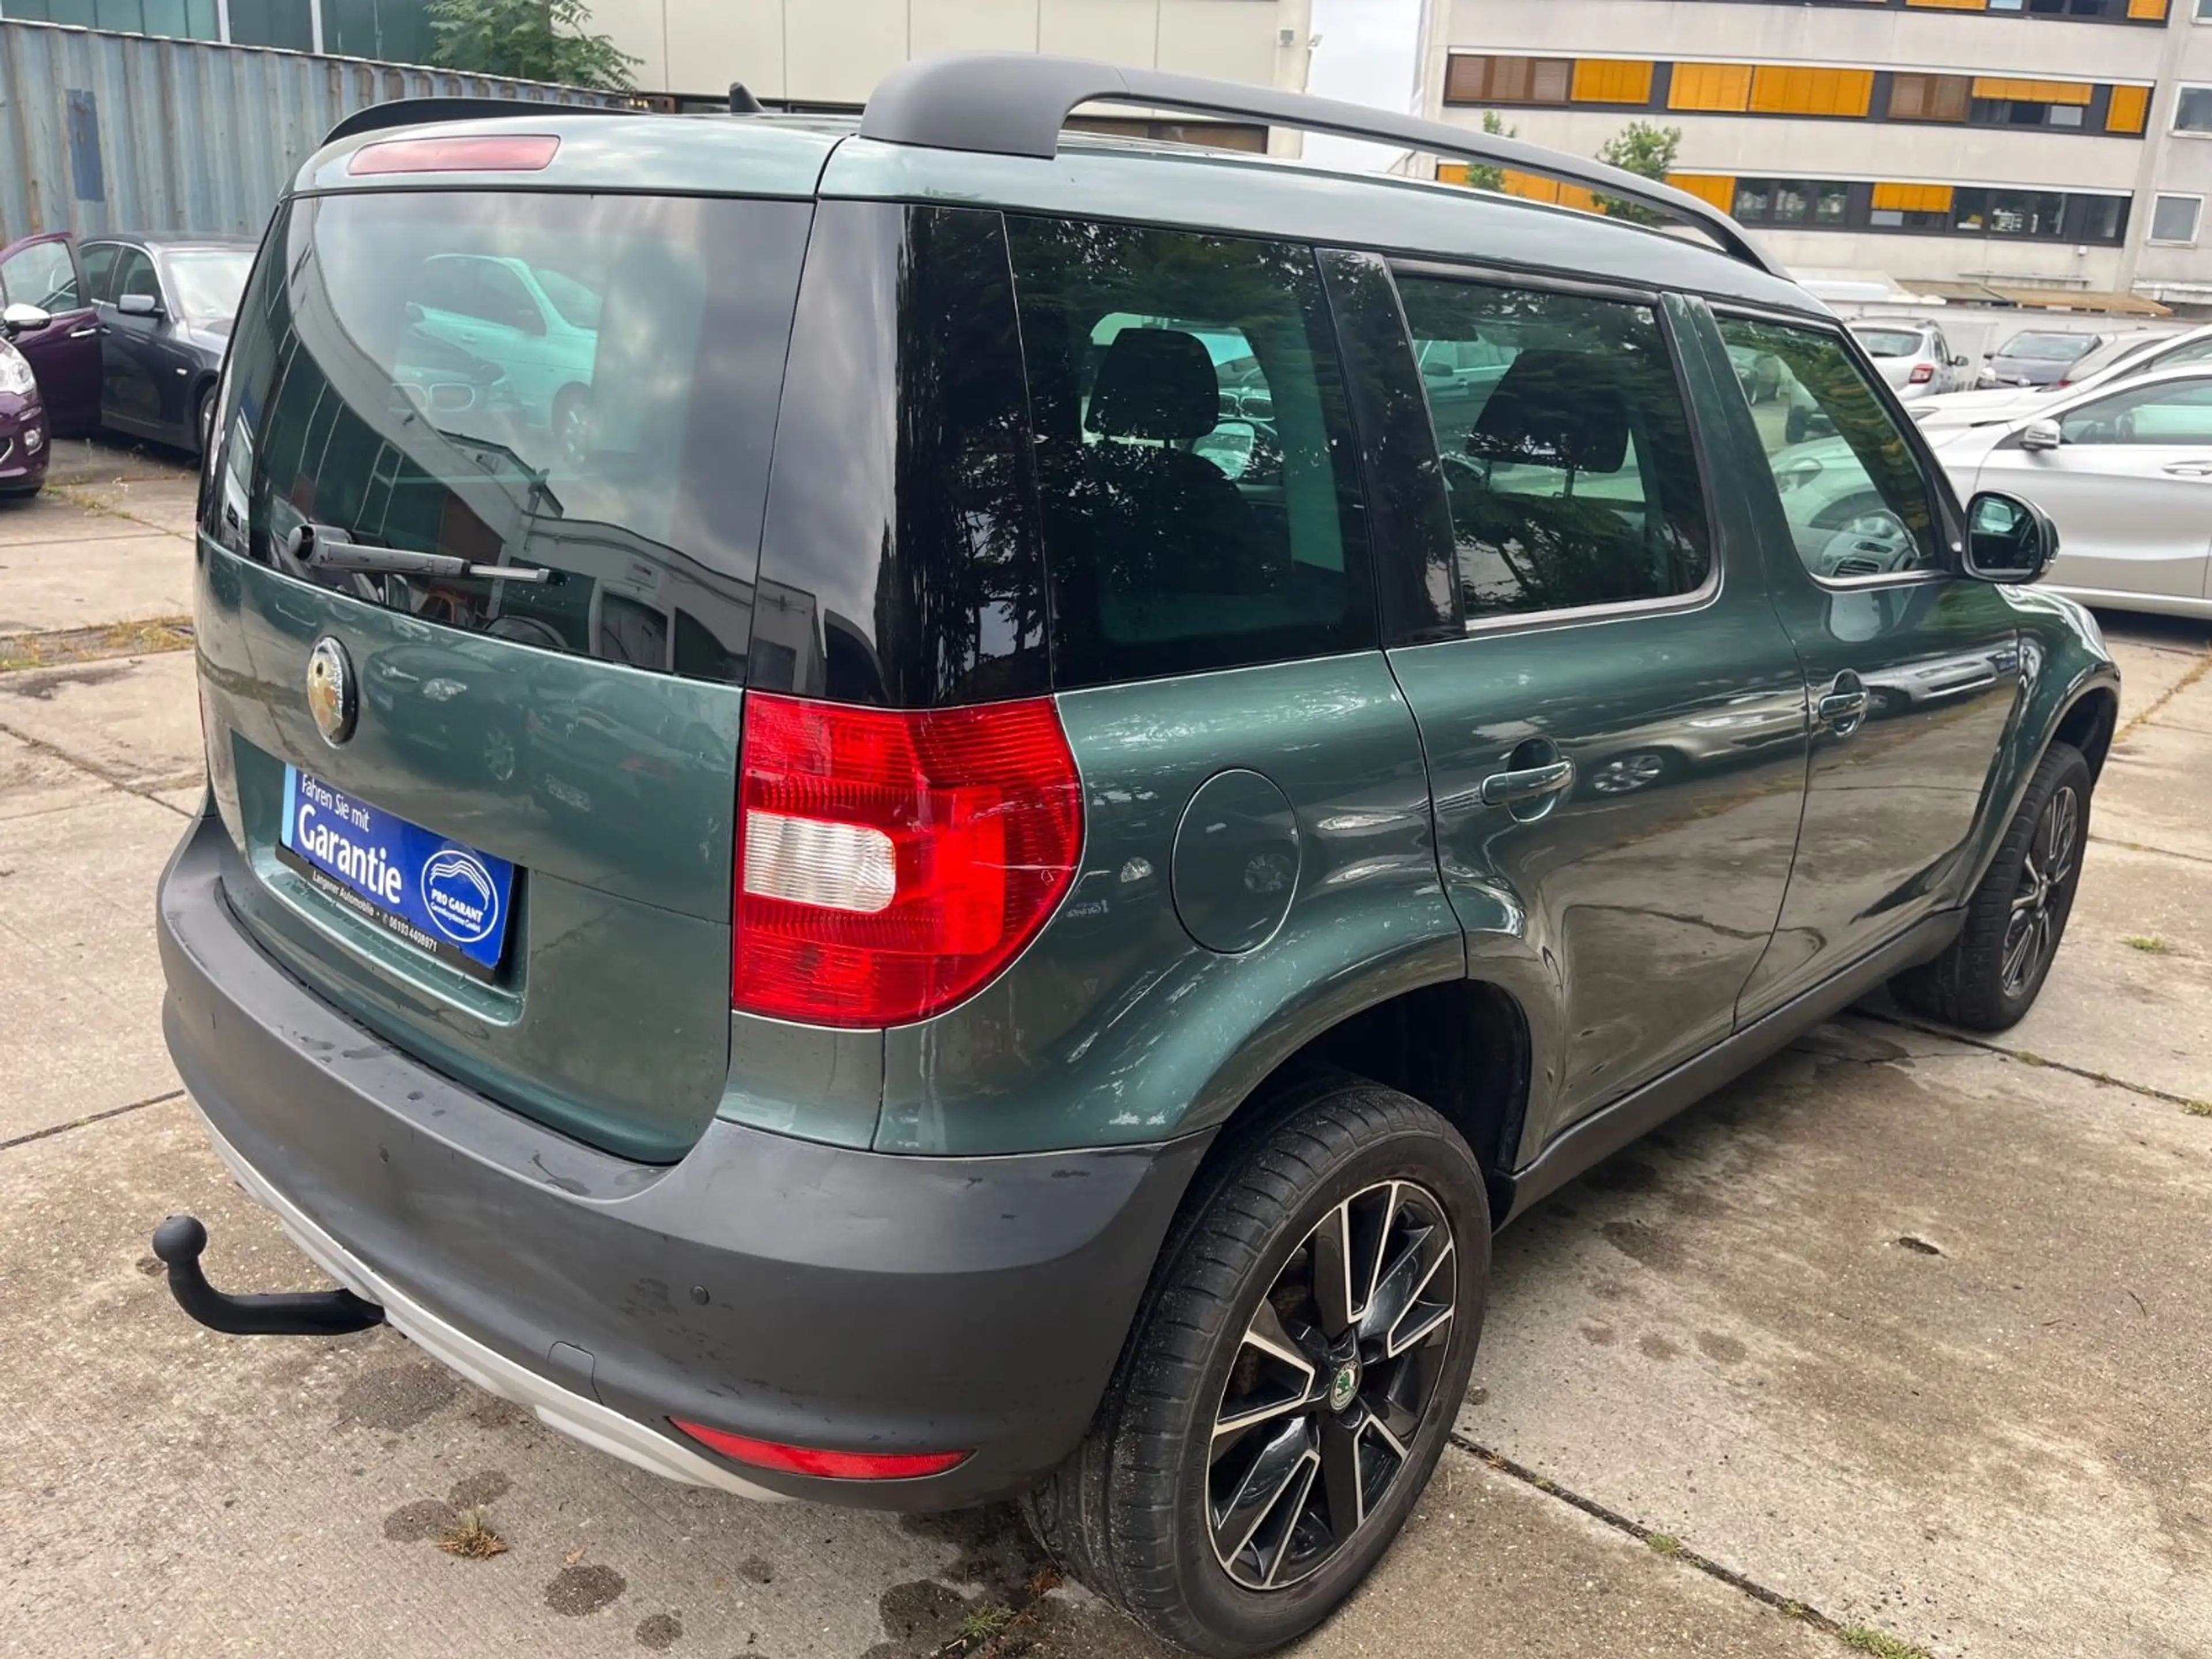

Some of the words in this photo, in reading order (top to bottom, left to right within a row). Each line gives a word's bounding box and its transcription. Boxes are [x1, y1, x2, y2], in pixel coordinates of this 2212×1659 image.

[301, 774, 332, 810] Fahren
[334, 793, 349, 820] Sie
[351, 808, 370, 833] mit
[298, 803, 402, 904] Garantie
[431, 888, 448, 906] PRO
[449, 896, 483, 923] GARANT
